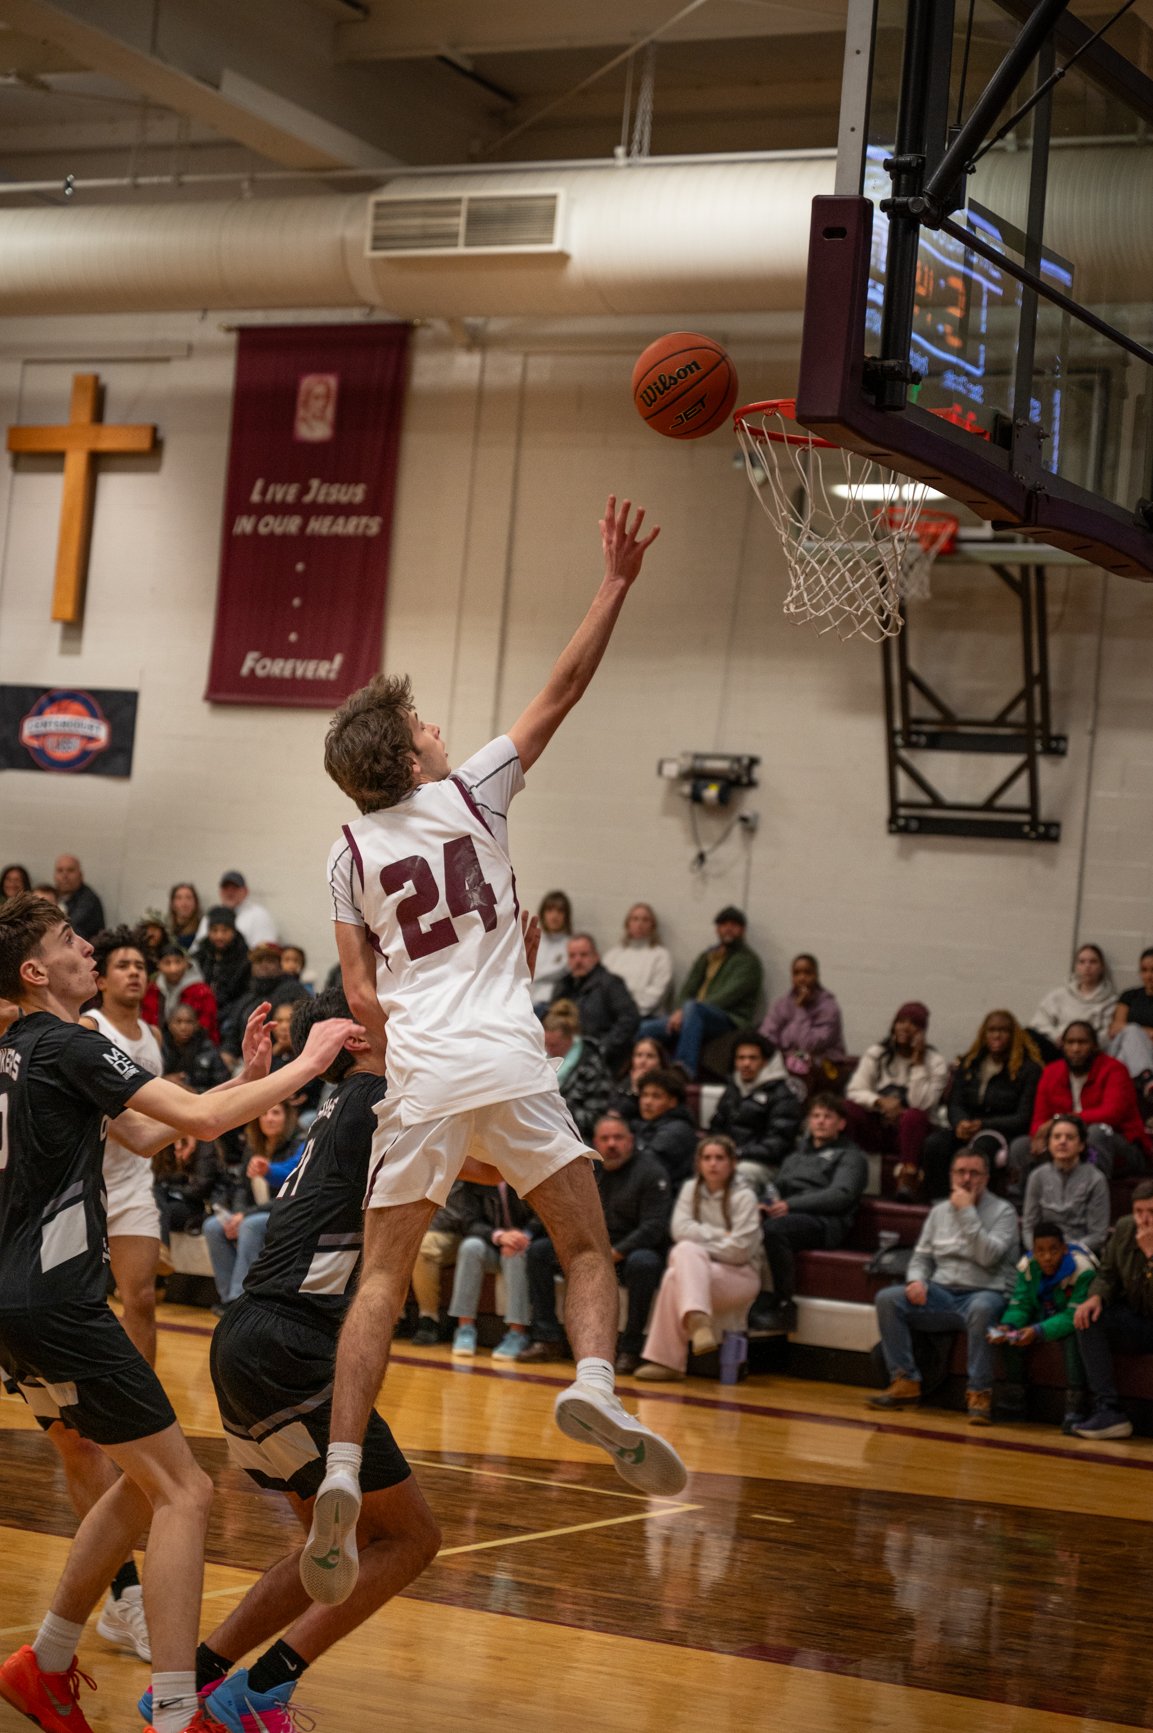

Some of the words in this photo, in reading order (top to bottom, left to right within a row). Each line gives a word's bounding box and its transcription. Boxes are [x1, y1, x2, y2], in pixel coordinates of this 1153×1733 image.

[639, 360, 702, 408] Wilson
[669, 391, 708, 430] JET
[257, 514, 302, 537] OUR
[305, 515, 383, 538] HEARTS
[240, 650, 344, 681] FOREVER!
[379, 834, 498, 962] 24
